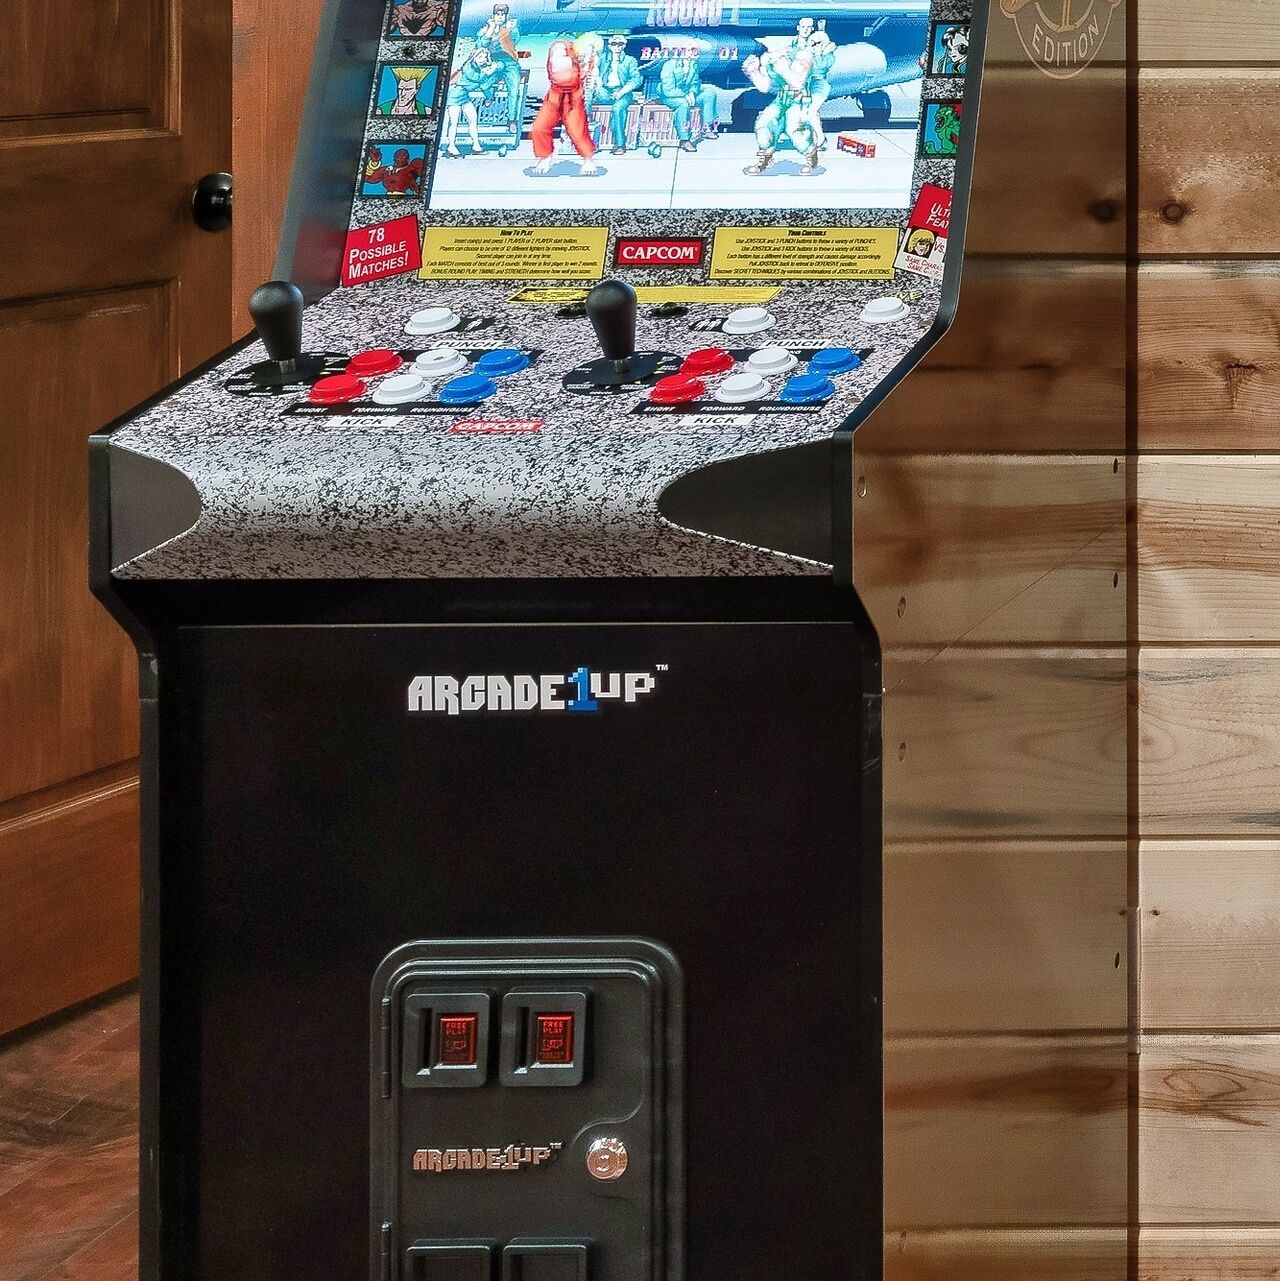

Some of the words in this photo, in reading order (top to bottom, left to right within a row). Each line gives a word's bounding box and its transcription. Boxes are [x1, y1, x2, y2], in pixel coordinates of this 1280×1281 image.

[1031, 14, 1100, 67] EDITION
[367, 227, 386, 244] 78
[349, 240, 408, 265] POSSIBLE
[622, 247, 695, 260] CAPCOM
[348, 253, 409, 280] MATCHES!
[436, 339, 501, 349] PUNCH
[764, 339, 828, 348] PUNCH
[340, 417, 383, 426] KICK
[455, 421, 534, 432] CAPCOM
[693, 416, 736, 425] KICK
